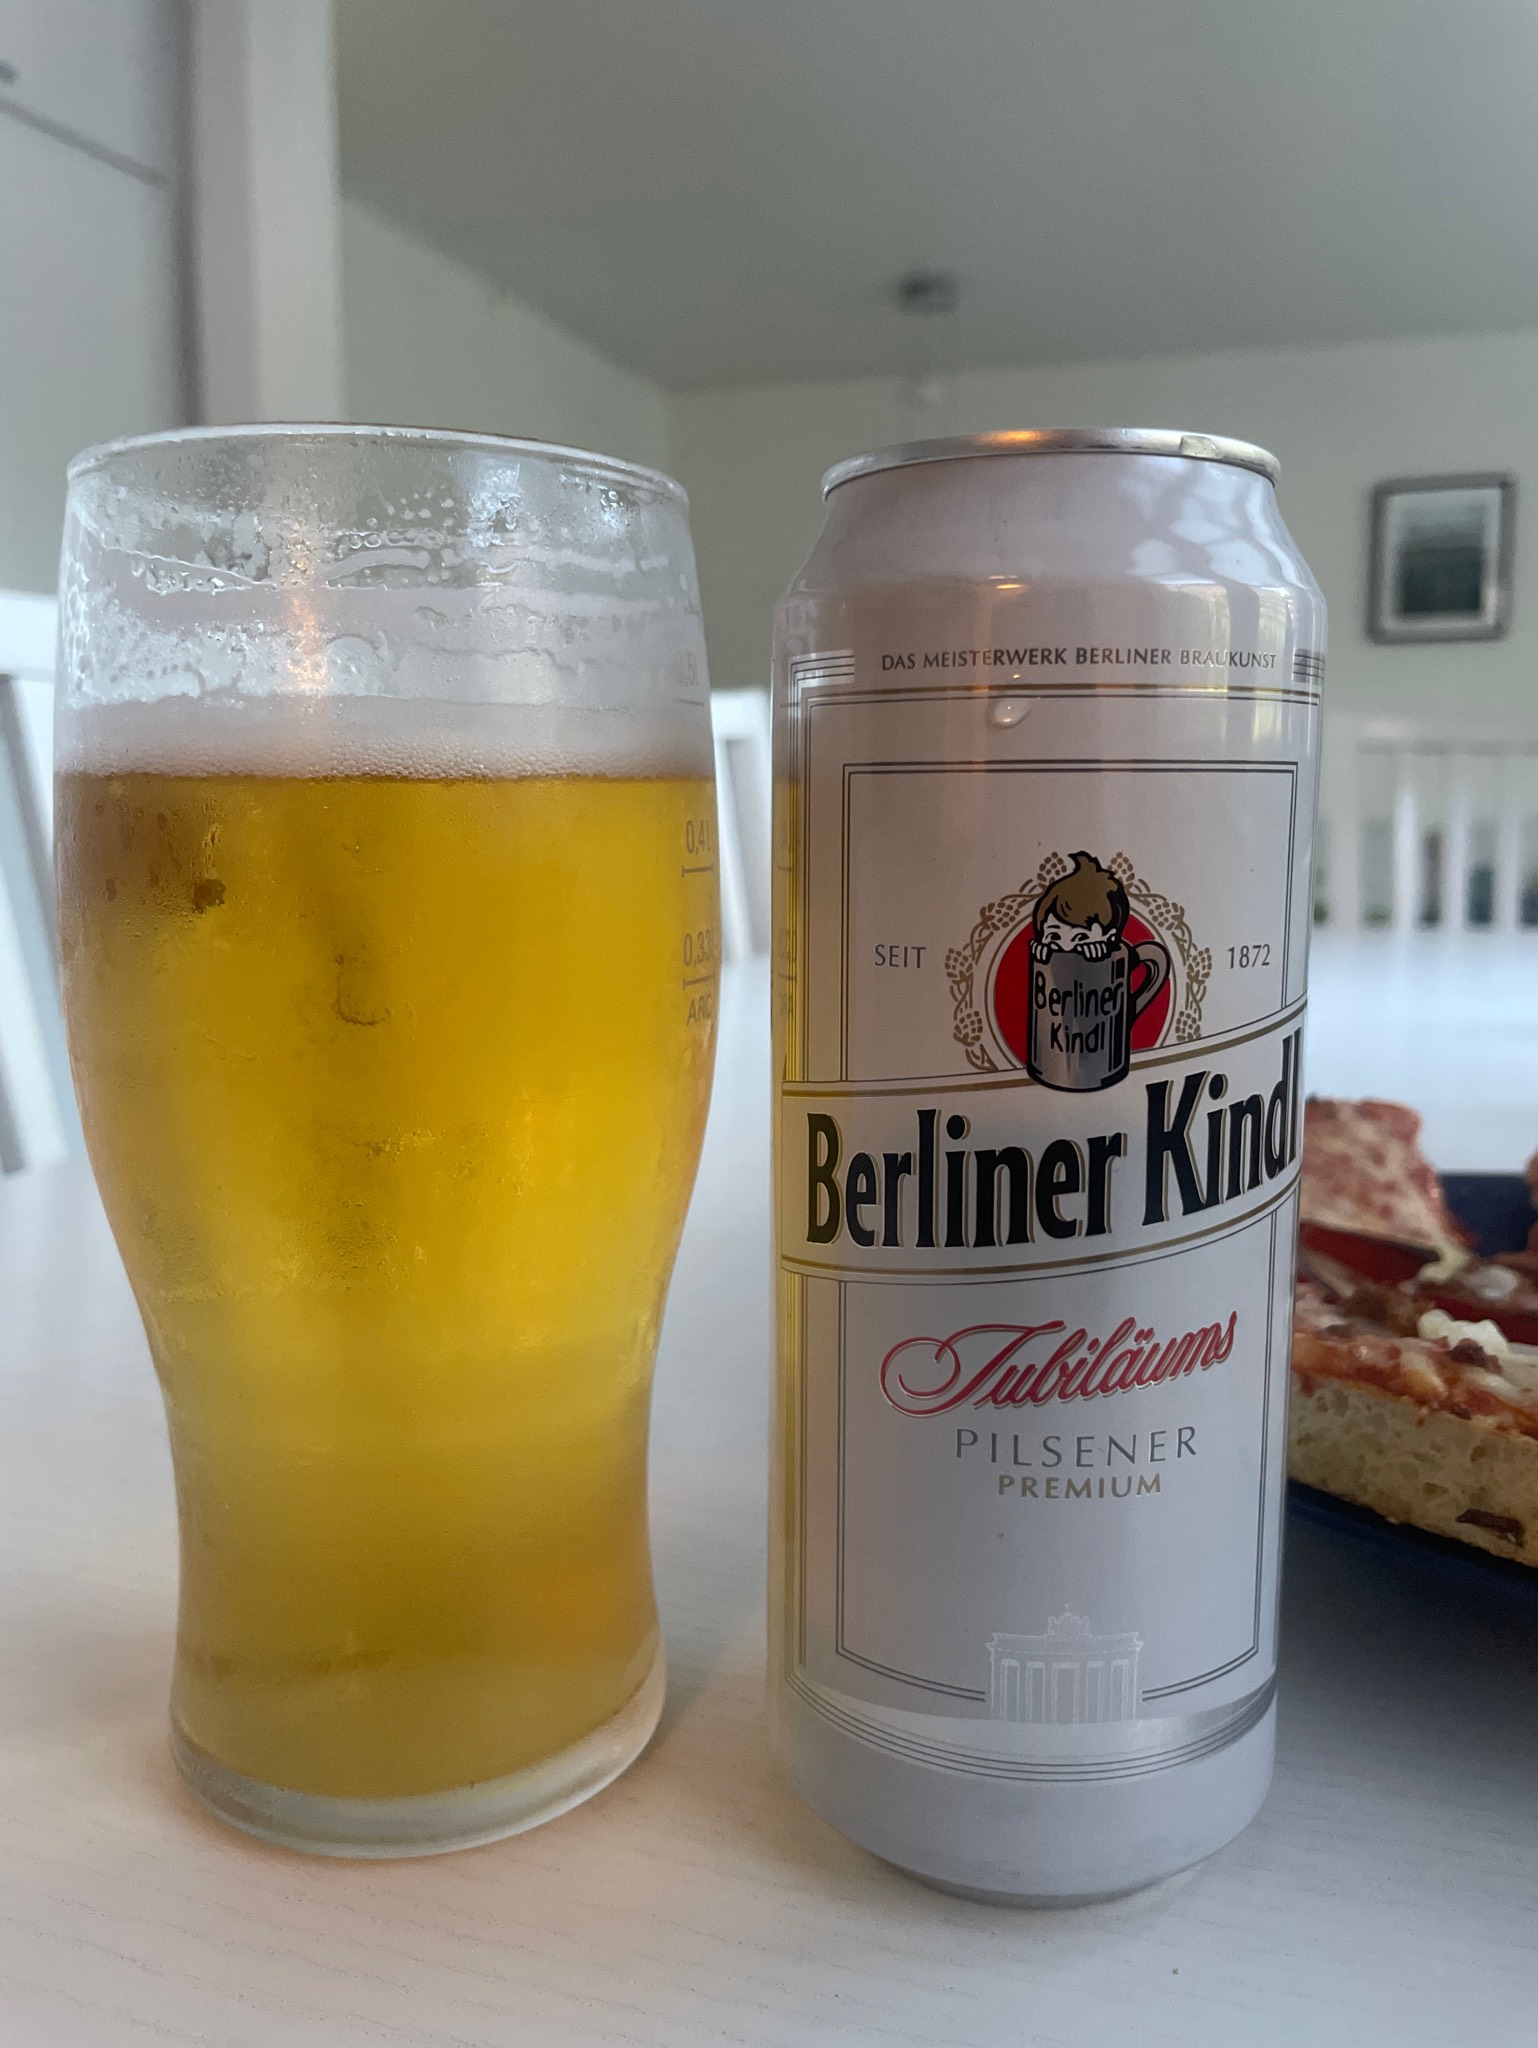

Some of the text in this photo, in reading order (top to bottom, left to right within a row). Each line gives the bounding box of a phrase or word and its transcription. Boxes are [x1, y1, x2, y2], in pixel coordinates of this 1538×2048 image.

[882, 647, 1278, 671] DAS MEISTERWERK BERLINER BRAUKUNST
[874, 944, 927, 969] SEIT
[1227, 944, 1271, 970] 1872
[1034, 970, 1124, 1018] Berliner
[1050, 1021, 1105, 1054] Kindl
[806, 1027, 1302, 1248] Berliner Kindl
[880, 1311, 1238, 1418] Jubiläums
[955, 1426, 1197, 1468] PILSENER
[998, 1473, 1162, 1499] PREMIUM
